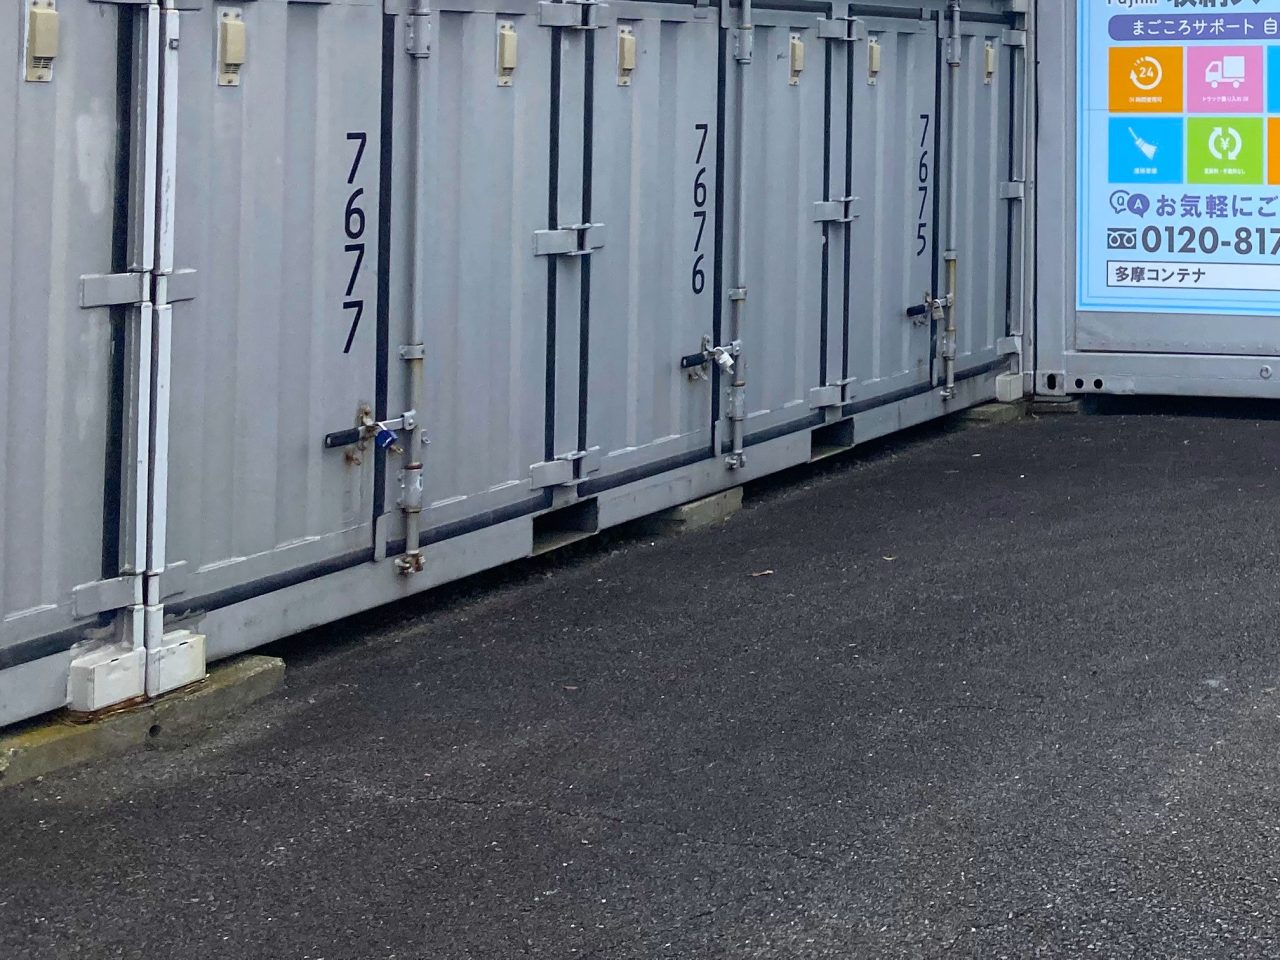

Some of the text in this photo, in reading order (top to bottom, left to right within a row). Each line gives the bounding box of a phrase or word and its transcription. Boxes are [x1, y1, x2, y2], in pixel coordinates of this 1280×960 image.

[1133, 18, 1254, 35] まごころサポート
[1139, 66, 1154, 78] 24
[916, 114, 930, 257] 7675
[691, 123, 708, 295] 7676
[1134, 198, 1143, 209] A
[342, 132, 367, 354] 7677
[1115, 266, 1206, 282] 多摩コンテナ
